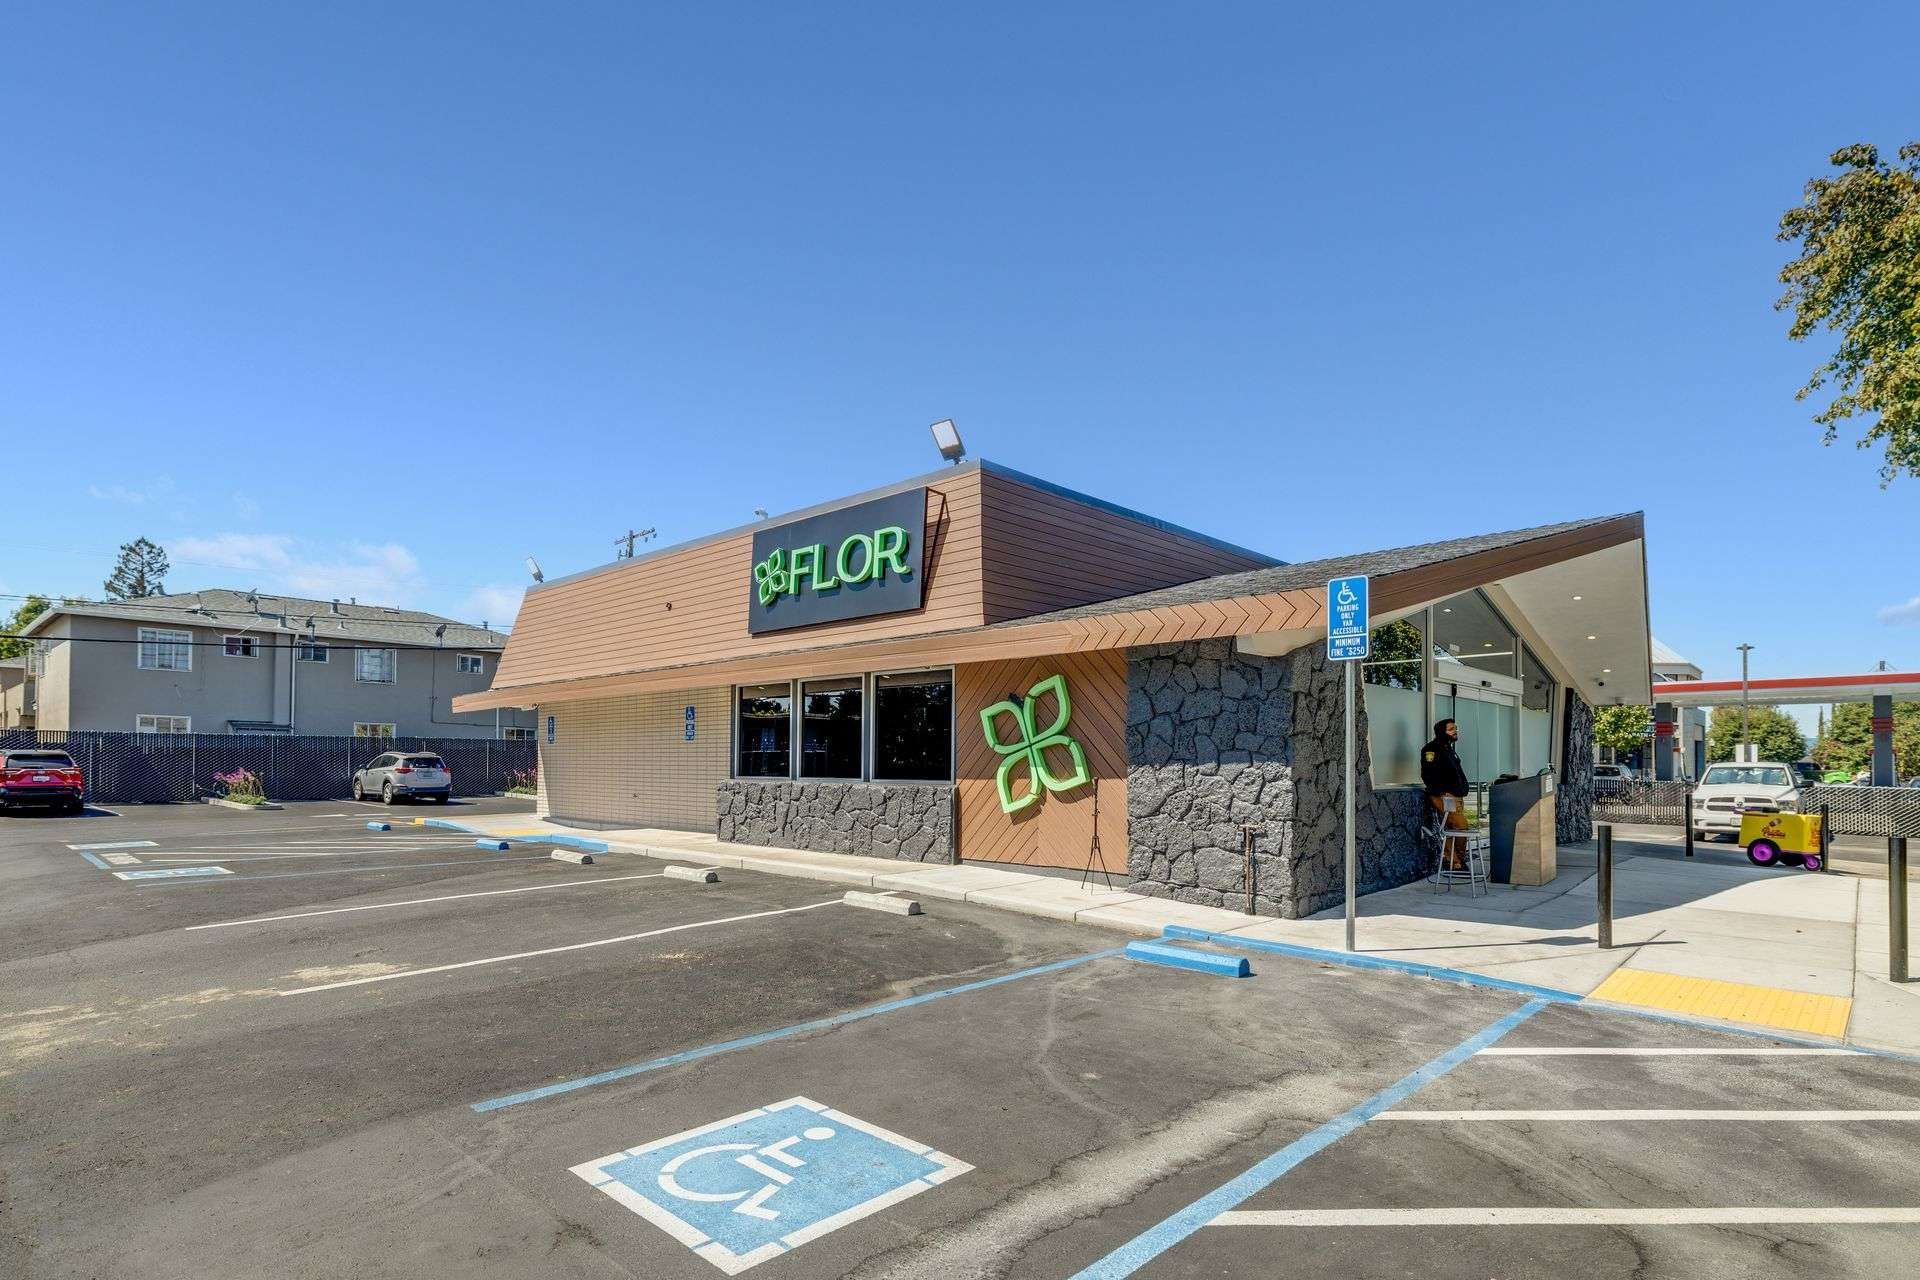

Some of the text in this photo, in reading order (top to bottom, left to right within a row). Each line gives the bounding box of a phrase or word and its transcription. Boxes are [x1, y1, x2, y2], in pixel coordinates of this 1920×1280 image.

[788, 526, 912, 595] FLOR
[1336, 604, 1359, 612] PARKING
[1333, 626, 1363, 635] ACCESSIBLE
[1336, 638, 1360, 646] MINIMUM
[1331, 646, 1364, 656] FINE $250
